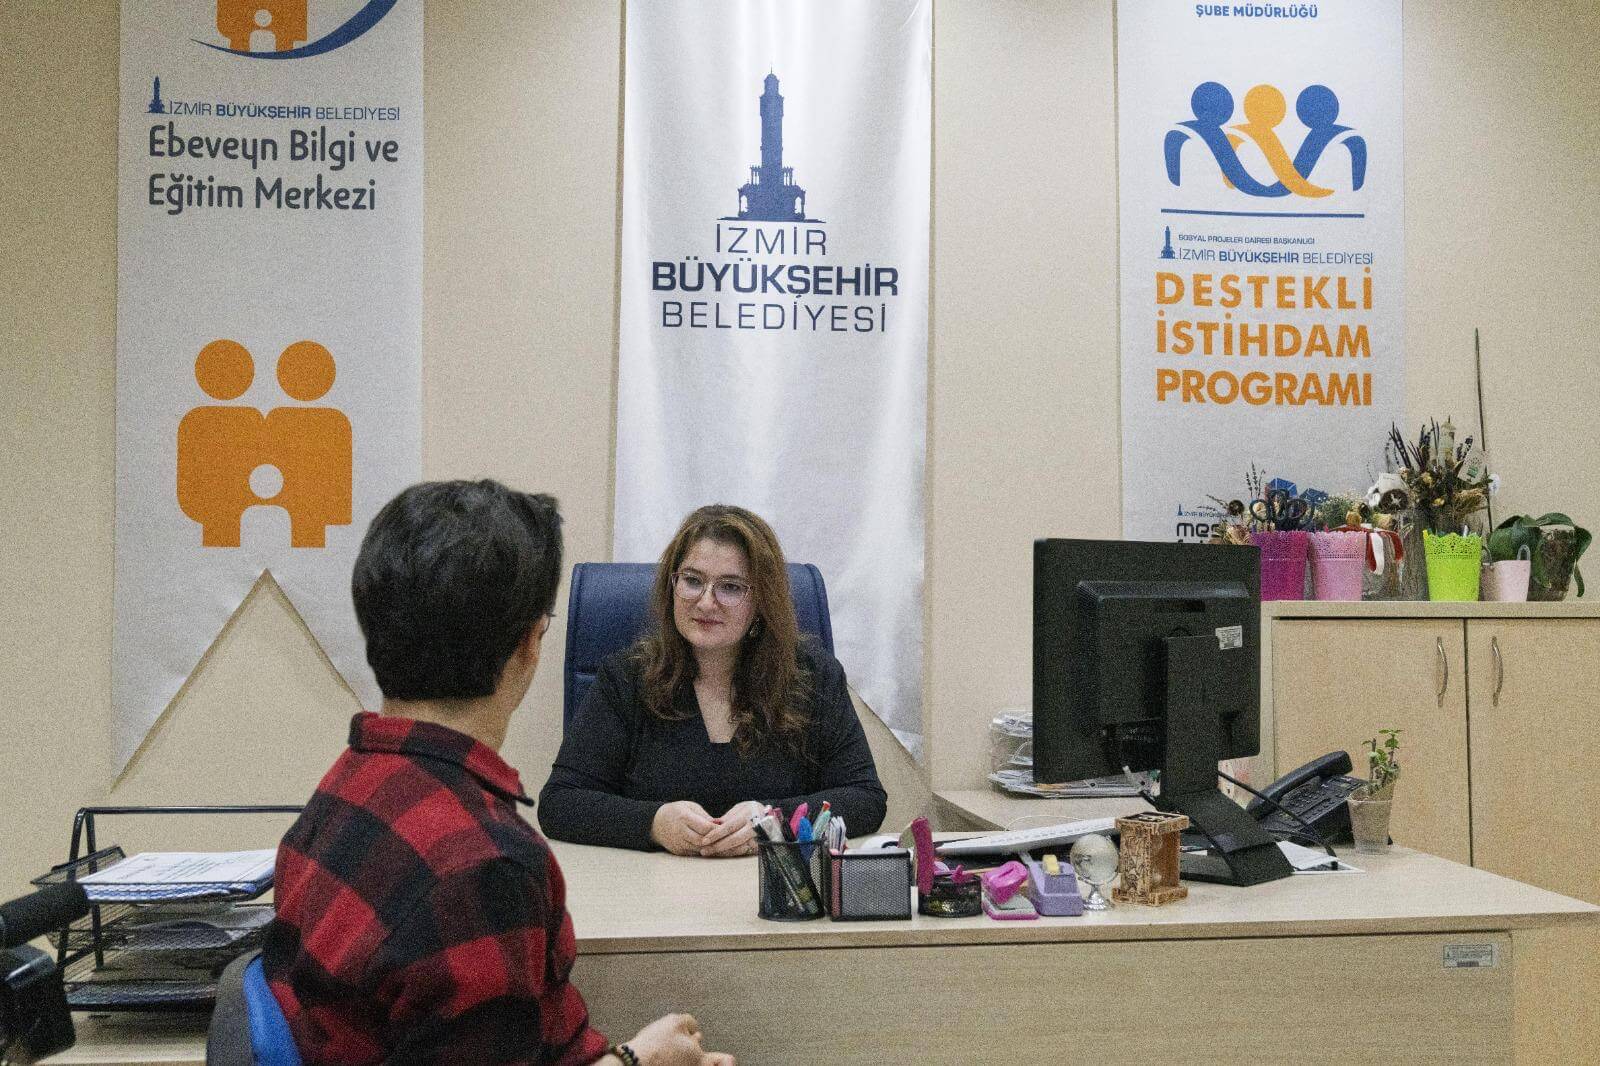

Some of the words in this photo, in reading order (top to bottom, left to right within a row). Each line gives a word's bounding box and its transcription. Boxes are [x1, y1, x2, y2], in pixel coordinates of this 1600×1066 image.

[1195, 4, 1230, 18] ŞUBE
[1233, 3, 1318, 18] MÜDÜRLÜĞÜ
[169, 101, 212, 116] İZMİR
[216, 102, 311, 119] BÜYÜKŞEHİR
[315, 105, 401, 121] BELEDİYESİ
[149, 121, 278, 169] Ebeveyn
[290, 126, 356, 171] Bilgi
[365, 138, 399, 163] ve
[149, 172, 244, 216] Eğitim
[255, 173, 376, 211] Merkezi
[716, 223, 827, 256] İZMİR
[1179, 248, 1216, 261] İZMİR
[1219, 249, 1299, 264] BÜYÜKŞEHİR
[1303, 251, 1374, 265] BELEDİYESİ
[1207, 235, 1243, 244] PROJELER
[652, 255, 899, 299] BÜYÜKŞEHİR
[1155, 266, 1374, 310] DESTEKLİ
[662, 301, 887, 333] BELEDİYESİ
[1156, 309, 1373, 358] İSTİHDAM
[1156, 367, 1373, 406] PROGRAMI
